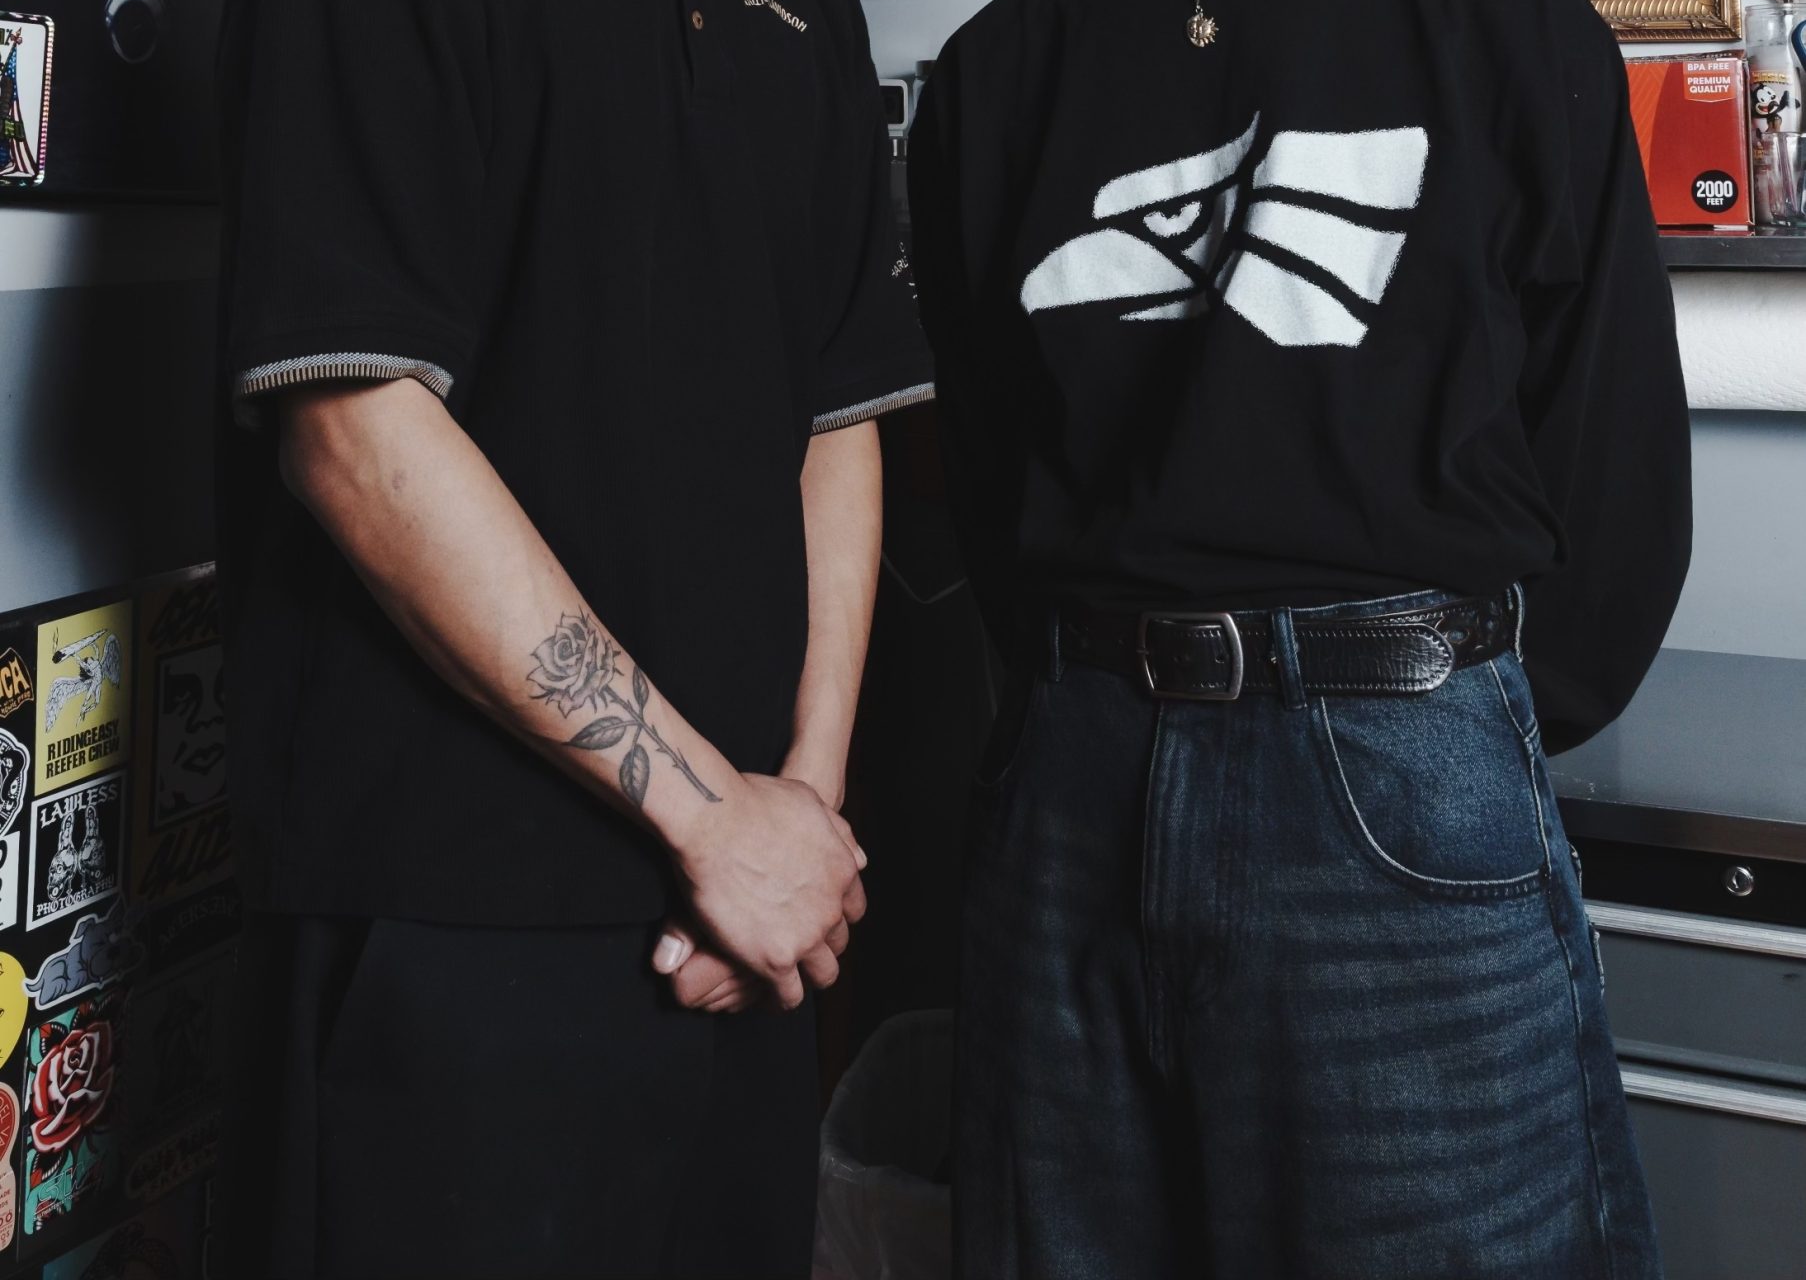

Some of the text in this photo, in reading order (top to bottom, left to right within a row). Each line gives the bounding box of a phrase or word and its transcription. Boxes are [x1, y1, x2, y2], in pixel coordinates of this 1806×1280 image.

[1687, 62, 1730, 71] BPA FREE
[1687, 76, 1731, 85] PREMIUM
[1689, 85, 1729, 94] QUALITY
[1696, 180, 1733, 198] 2000
[1706, 197, 1724, 206] FEET
[47, 718, 119, 762] RIDINGEASY
[46, 736, 119, 779] REEFER CREW
[40, 783, 118, 829] LAWLESS
[36, 873, 115, 917] PHOTOGRAPHY
